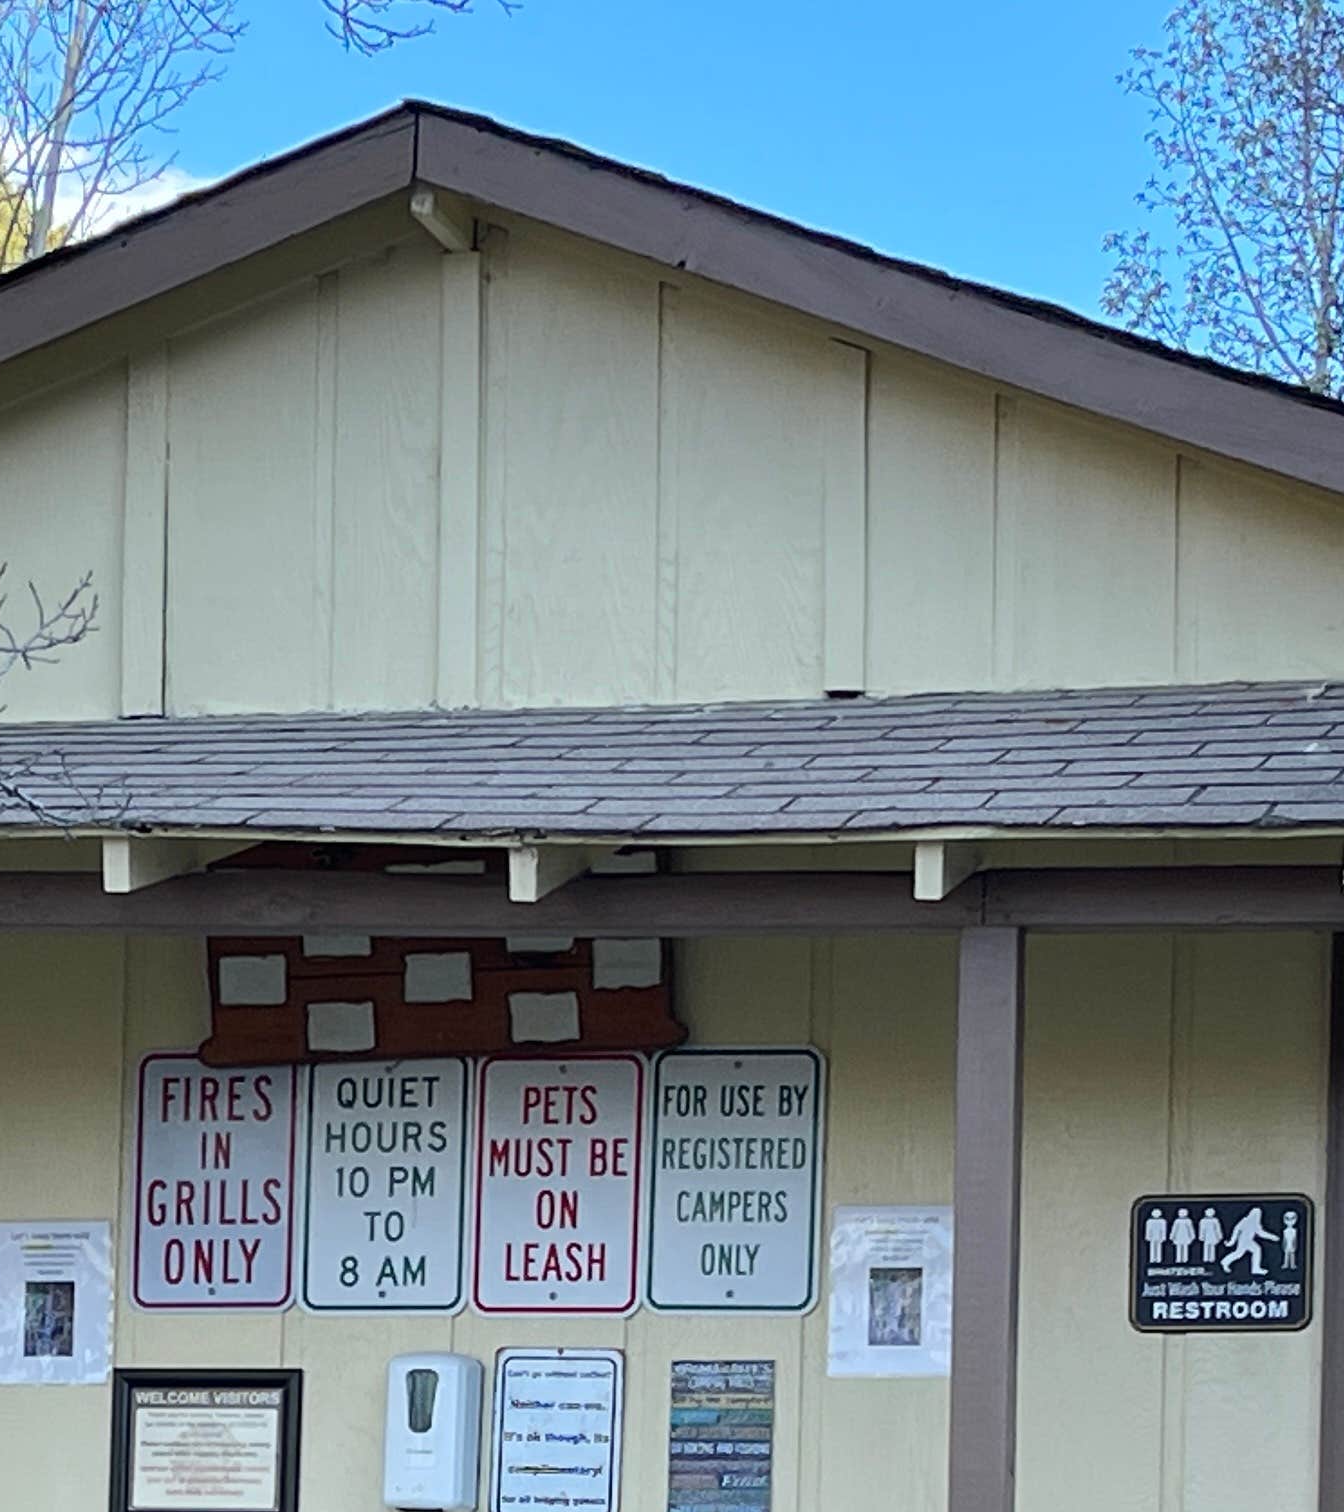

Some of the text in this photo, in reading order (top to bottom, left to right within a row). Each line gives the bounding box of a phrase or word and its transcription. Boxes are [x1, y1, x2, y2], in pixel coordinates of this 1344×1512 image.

[161, 1075, 273, 1123] FIRES
[337, 1076, 441, 1109] QUIET
[522, 1085, 598, 1125] PETS
[663, 1085, 810, 1118] FOR USE BY
[200, 1131, 232, 1170] IN
[324, 1121, 448, 1153] HOURS
[661, 1137, 806, 1170] REGISTERED
[489, 1137, 629, 1178] MUST BE
[336, 1166, 436, 1198] 10 PM
[147, 1178, 282, 1227] GRILLS
[536, 1190, 578, 1230] ON
[676, 1190, 788, 1223] CAMPERS
[363, 1210, 405, 1242] TO
[164, 1238, 262, 1286] ONLY
[340, 1255, 426, 1288] 8 AM
[505, 1242, 606, 1282] LEASH
[700, 1243, 761, 1277] ONLY
[1142, 1280, 1301, 1297] Just Wash Your Hands Please
[1152, 1301, 1289, 1319] RESTROOM
[135, 1391, 281, 1405] WELCOME VISITORS
